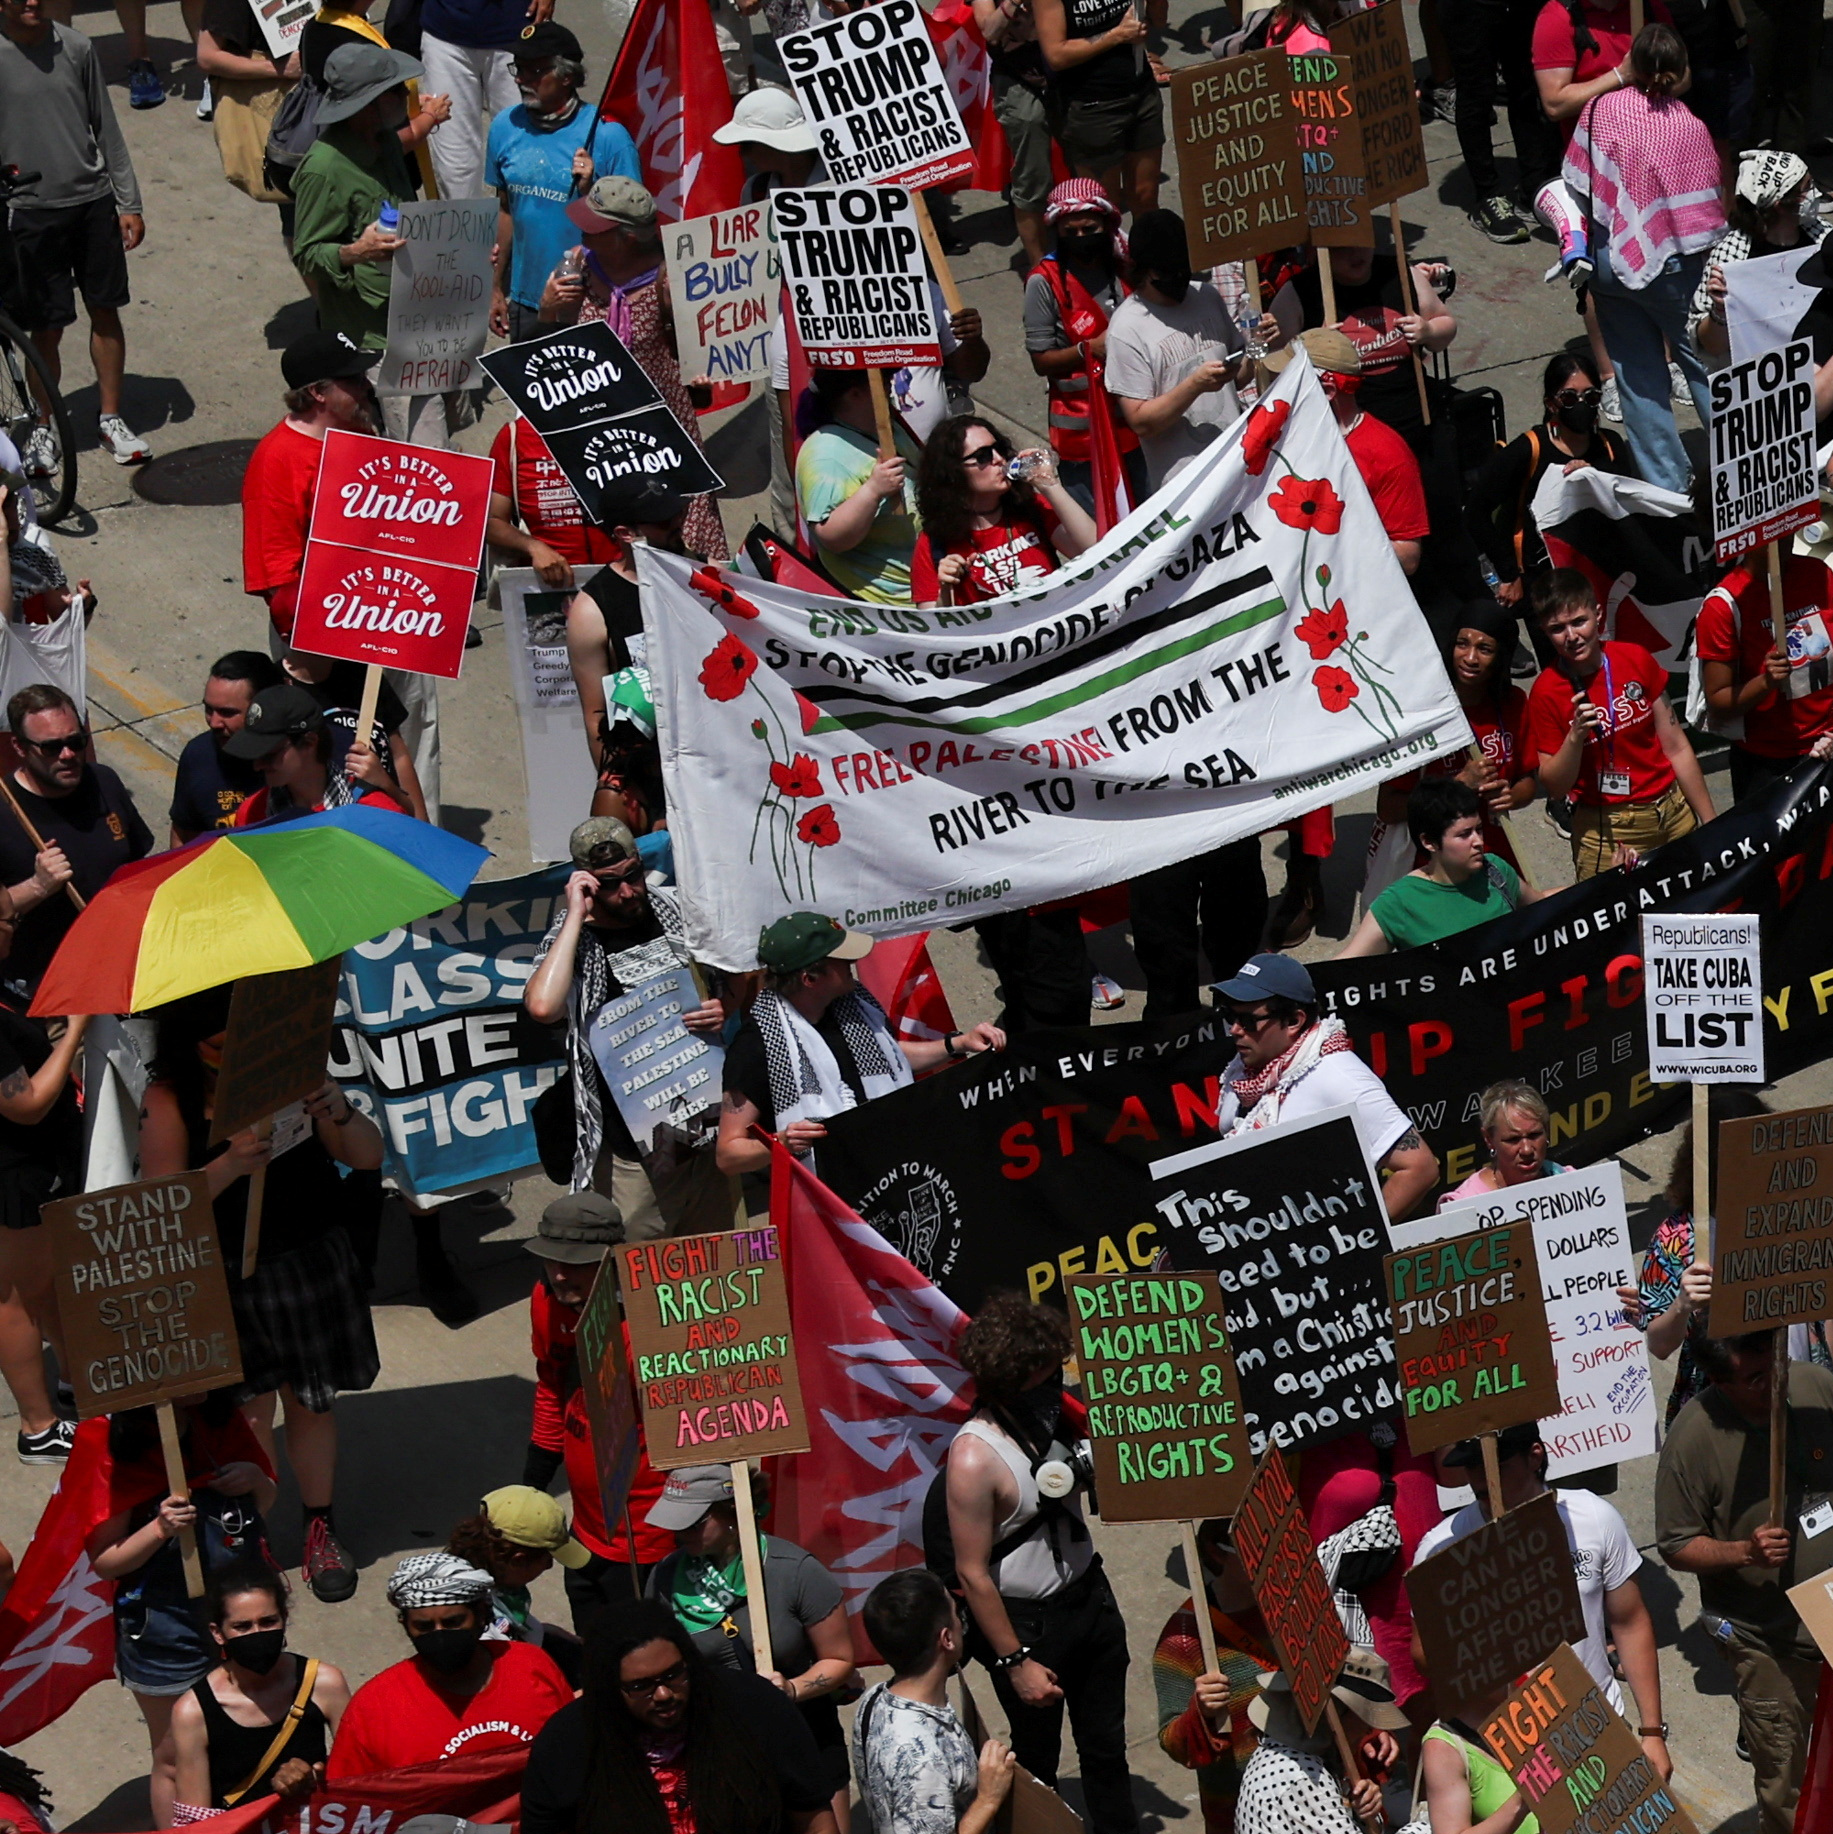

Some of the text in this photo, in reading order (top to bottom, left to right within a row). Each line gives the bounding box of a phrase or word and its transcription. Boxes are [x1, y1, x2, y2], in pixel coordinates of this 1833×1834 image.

[1191, 63, 1269, 105] PEACE
[1185, 94, 1284, 143] JUSTICE
[1214, 133, 1265, 171] AND
[507, 182, 568, 203] ORGANIZE
[1201, 162, 1287, 208] EQUITY
[772, 187, 910, 227] STOP
[1203, 195, 1300, 243] FOR ALL
[401, 211, 498, 246] DON'T DRINK
[676, 209, 760, 259] A LIAR
[437, 250, 456, 270] THE
[780, 232, 918, 277] TRUMP
[411, 274, 483, 301] KOOL-AID
[684, 251, 759, 301] BULLY
[795, 274, 926, 316] & RACIST
[398, 313, 474, 332] THEY WANT
[697, 294, 767, 346] FELON
[800, 313, 932, 341] REPUBLICANS
[400, 360, 471, 389] AFRAID
[358, 455, 454, 495] IT'S BETTER
[340, 482, 463, 526] Union
[378, 532, 415, 544] AFL-CIO
[1106, 643, 1291, 754] FROM THE
[1272, 728, 1440, 802] antiwarchicago.org
[928, 748, 1257, 854] RIVER TO SEA
[845, 878, 1012, 928] Committee Chicago
[1653, 925, 1751, 949] Republicans!
[1654, 957, 1752, 988] TAKE CUBA
[597, 978, 679, 1029] FROM THE
[1655, 994, 1753, 1006] OFF THE
[609, 1001, 682, 1049] RIVER TO
[1656, 1013, 1753, 1048] LIST
[620, 1026, 690, 1068] THE SEA,
[622, 1040, 709, 1096] PALESTINE
[643, 1068, 710, 1110] WILL BE
[1656, 1065, 1758, 1074] WWW.WICUBA.ORG
[667, 1097, 709, 1127] FREE
[626, 1227, 778, 1291] FIGHT THE
[655, 1267, 764, 1327] RACIST
[1076, 1281, 1205, 1320] DEFEND
[687, 1316, 741, 1350] AND
[639, 1334, 789, 1382] REACTIONARY
[646, 1364, 783, 1409] REPUBLICAN
[1088, 1363, 1224, 1398] LBGTQ+ &
[676, 1395, 790, 1448] AGENDA
[1089, 1402, 1236, 1440] REPRODUCTIVE
[1118, 1433, 1235, 1484] RIGHTS
